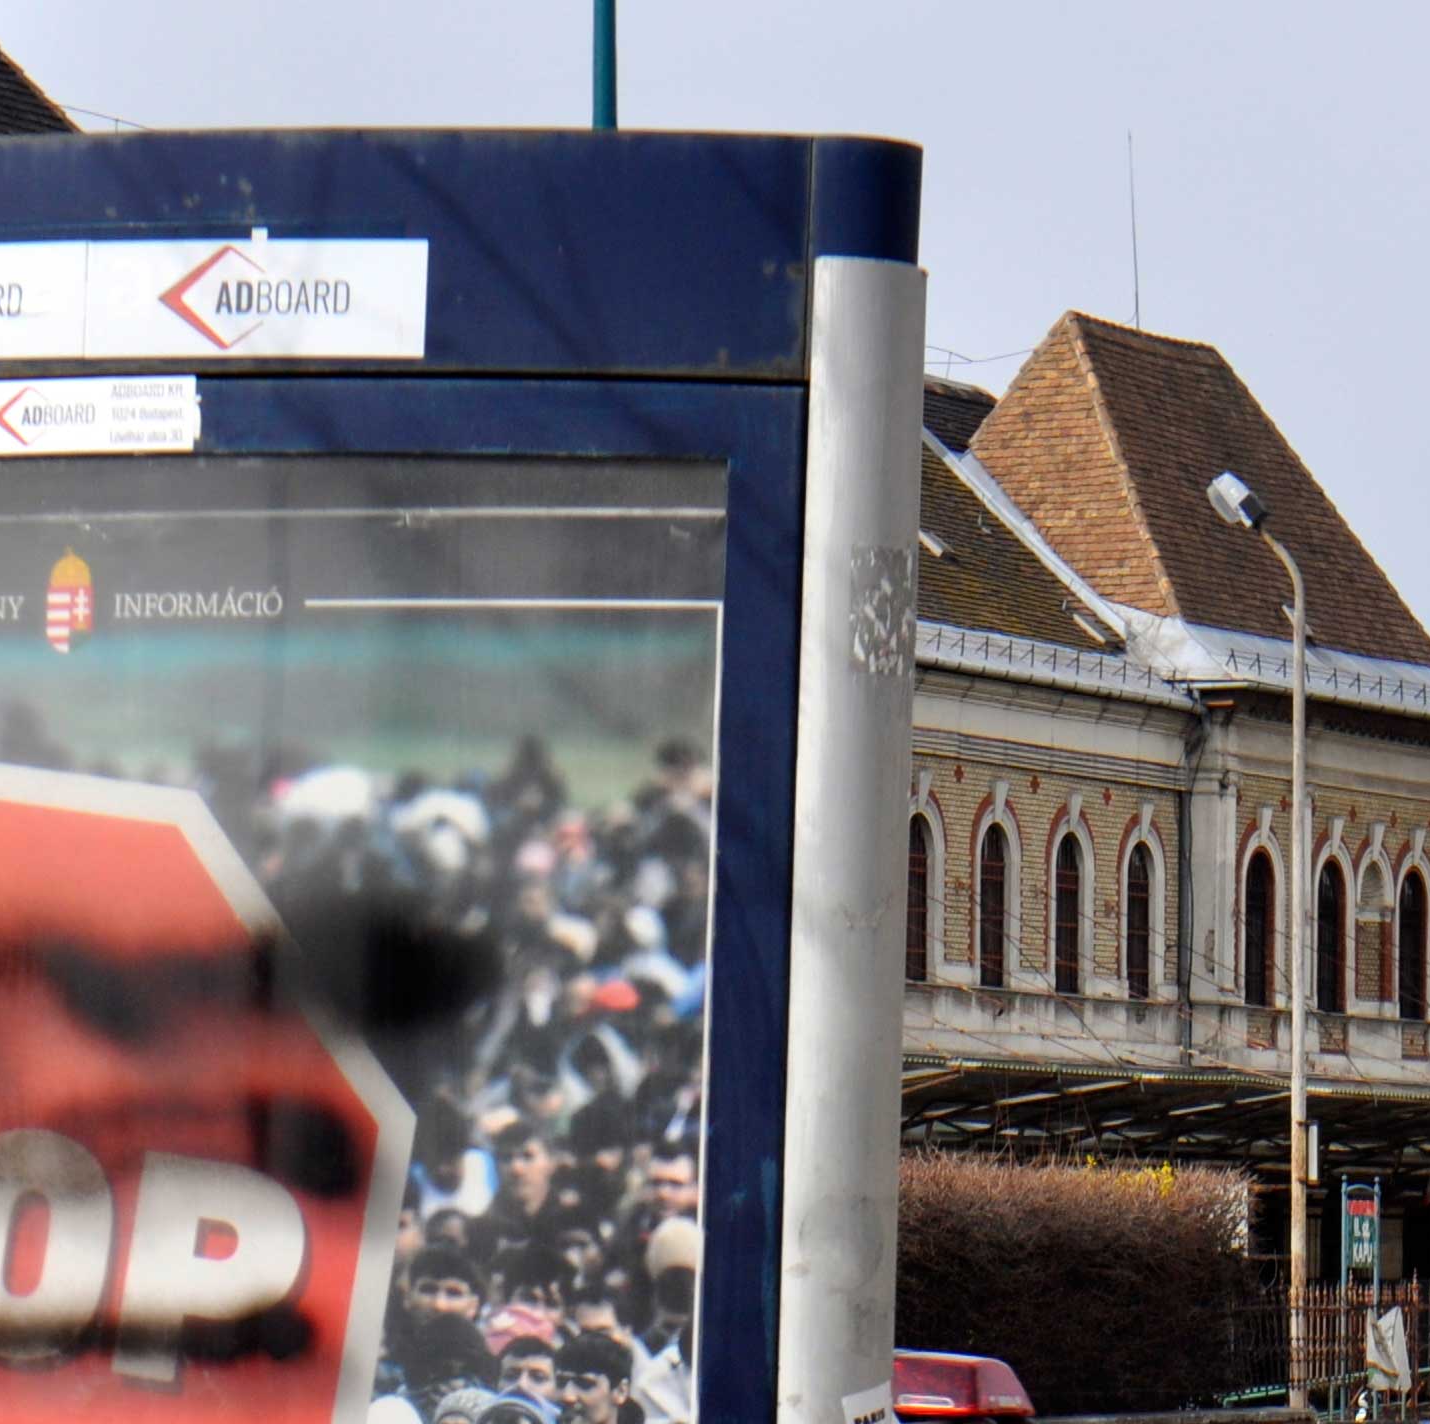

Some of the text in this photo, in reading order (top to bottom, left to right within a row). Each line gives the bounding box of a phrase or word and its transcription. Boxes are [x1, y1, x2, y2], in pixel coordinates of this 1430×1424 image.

[215, 279, 352, 316] ADBOARD
[21, 403, 96, 427] ADBOARD
[114, 586, 284, 619] INFORMÁCIÓ
